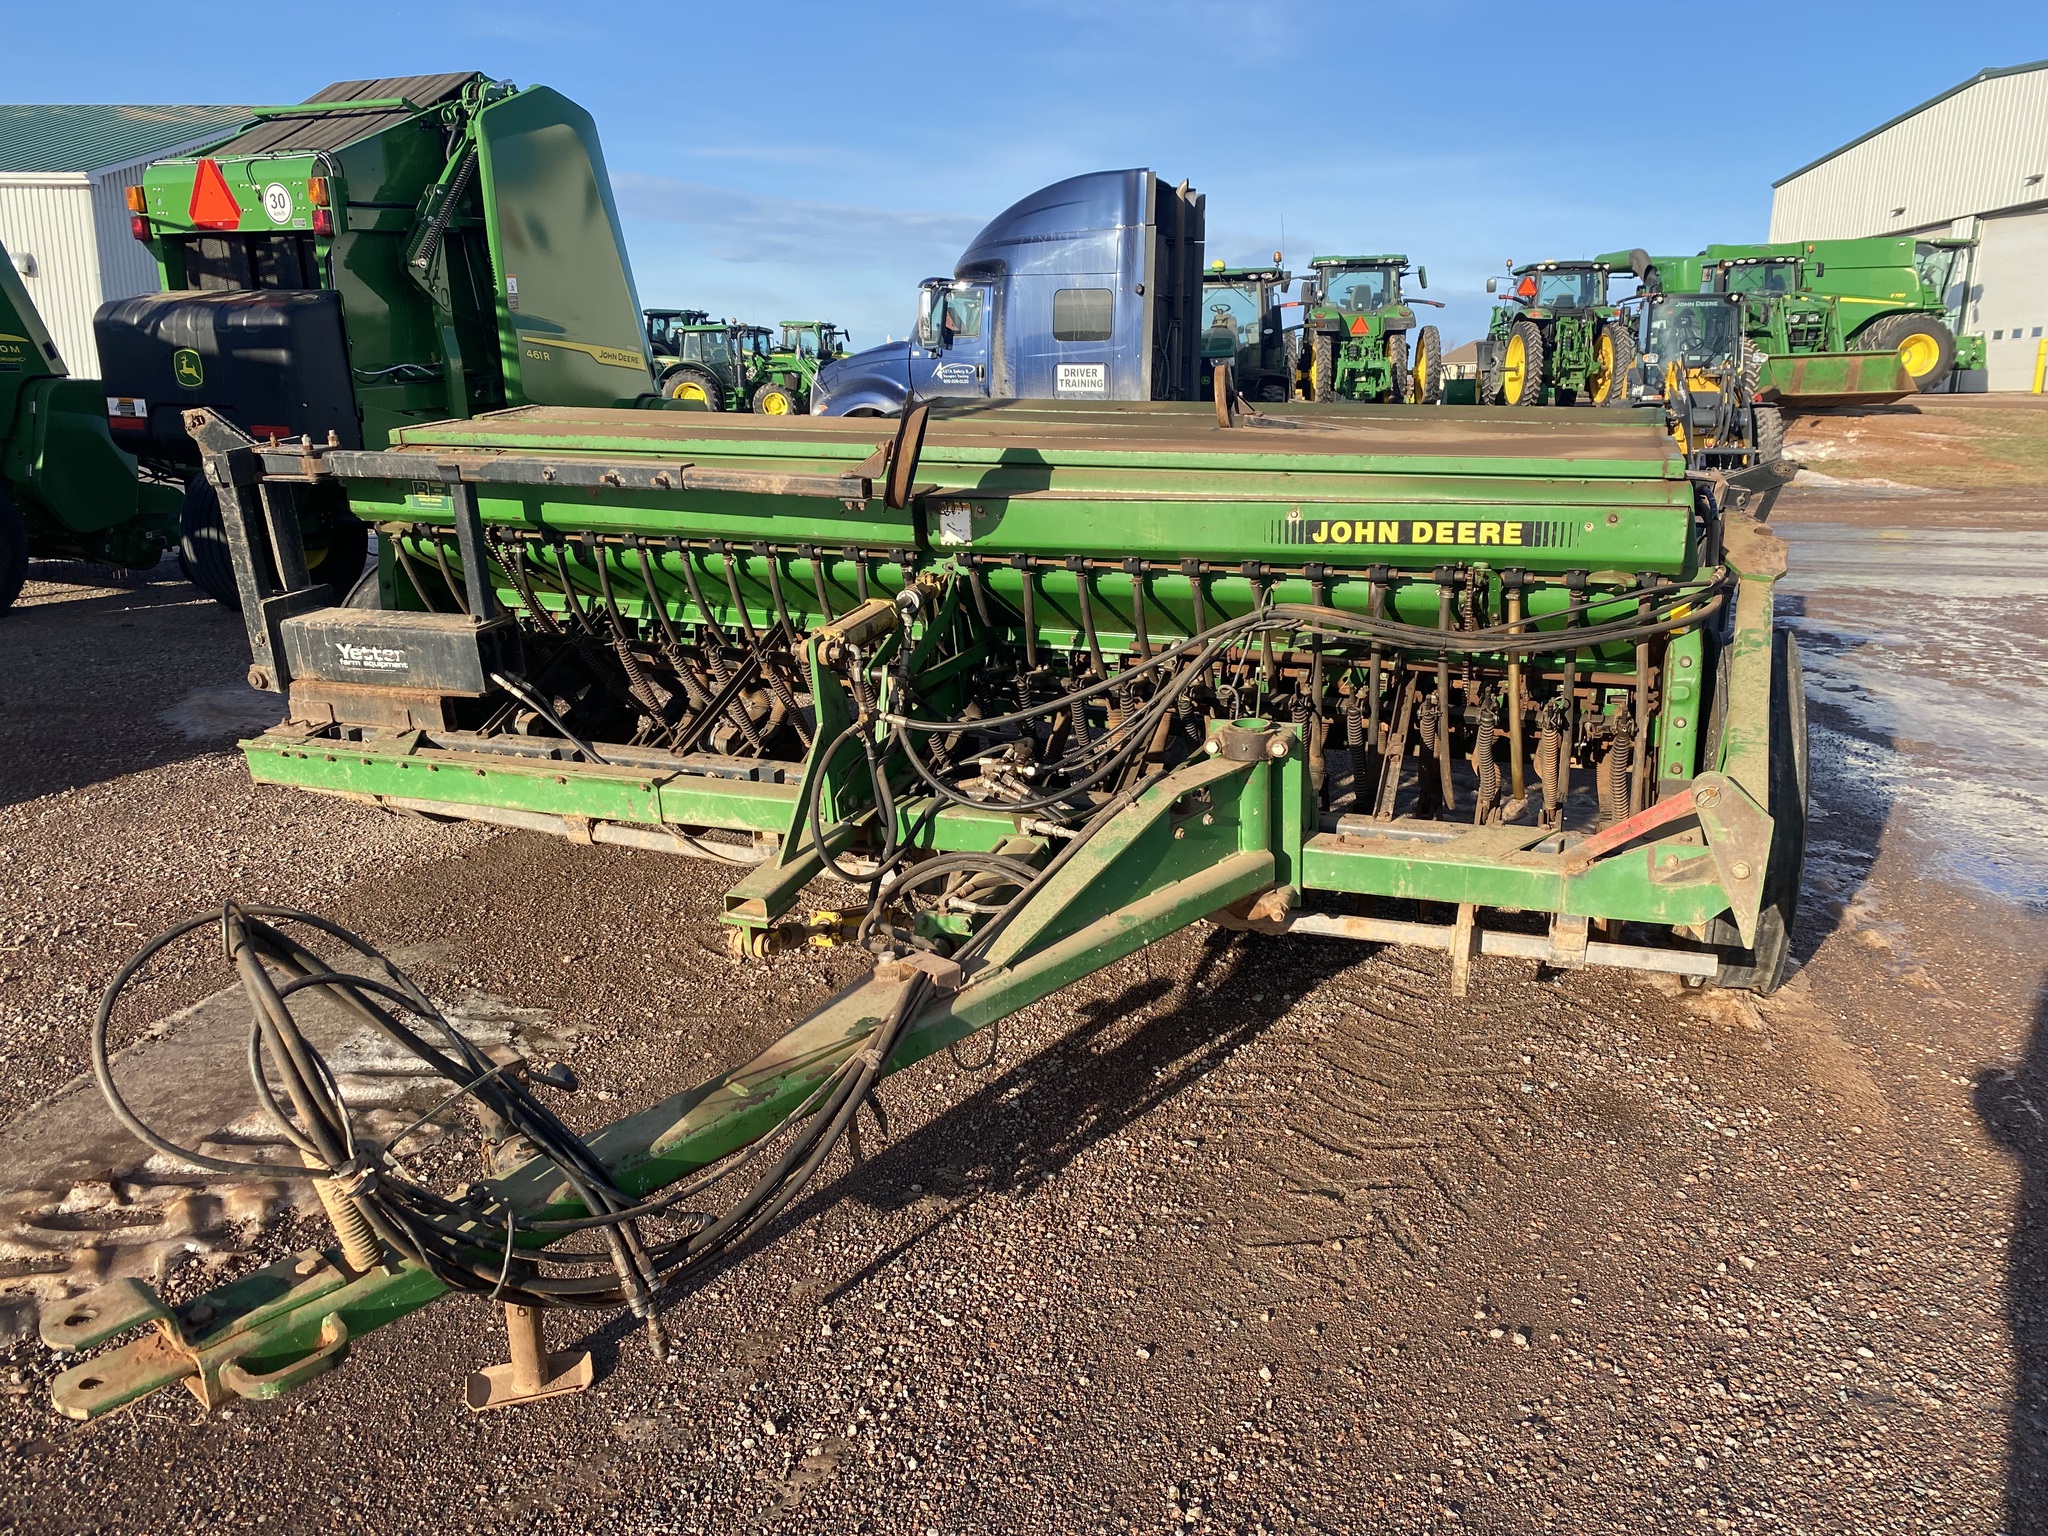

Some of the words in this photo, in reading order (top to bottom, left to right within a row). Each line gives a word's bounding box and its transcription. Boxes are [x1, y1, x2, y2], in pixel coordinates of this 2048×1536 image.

[269, 193, 286, 209] 30
[526, 348, 551, 362] 461R
[598, 350, 618, 361] JOHN
[618, 352, 640, 364] DEERE
[1064, 368, 1098, 378] DRIVER
[1059, 379, 1104, 388] TRAINING
[1311, 521, 1399, 543] JOHN
[1411, 521, 1523, 545] DEERE
[334, 642, 406, 662] Yetter
[339, 658, 361, 666] farm
[363, 660, 409, 669] equipment
